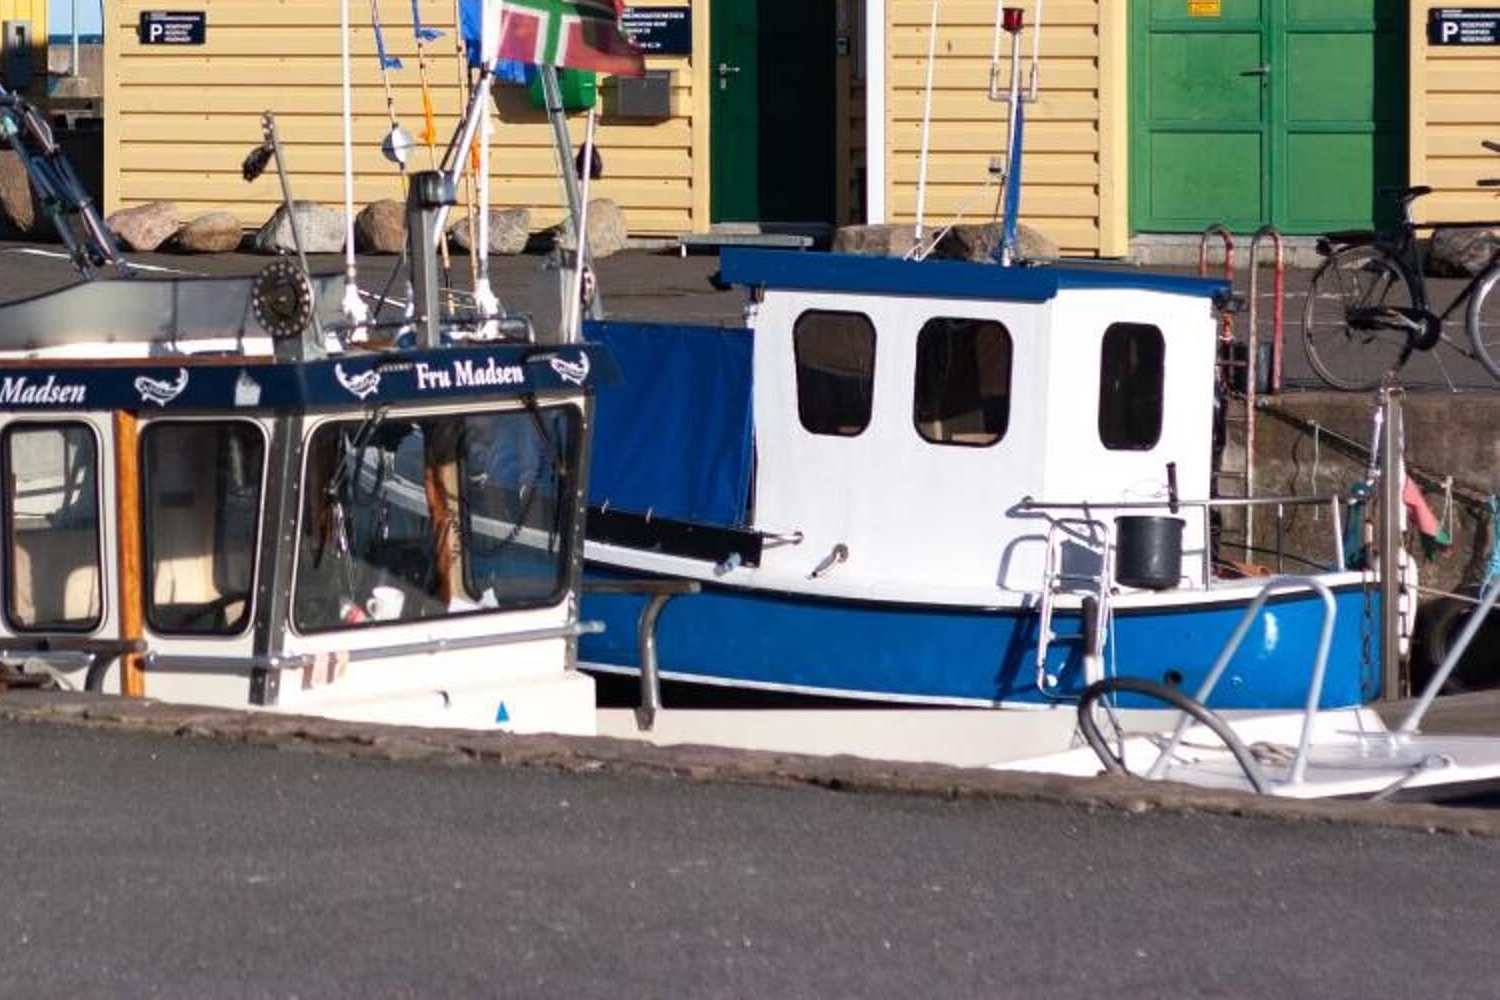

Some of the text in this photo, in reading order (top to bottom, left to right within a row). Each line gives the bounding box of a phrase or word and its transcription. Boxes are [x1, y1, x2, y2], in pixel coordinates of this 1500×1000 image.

[149, 23, 163, 42] P
[1442, 21, 1459, 43] P
[415, 356, 525, 390] Fru Madsen
